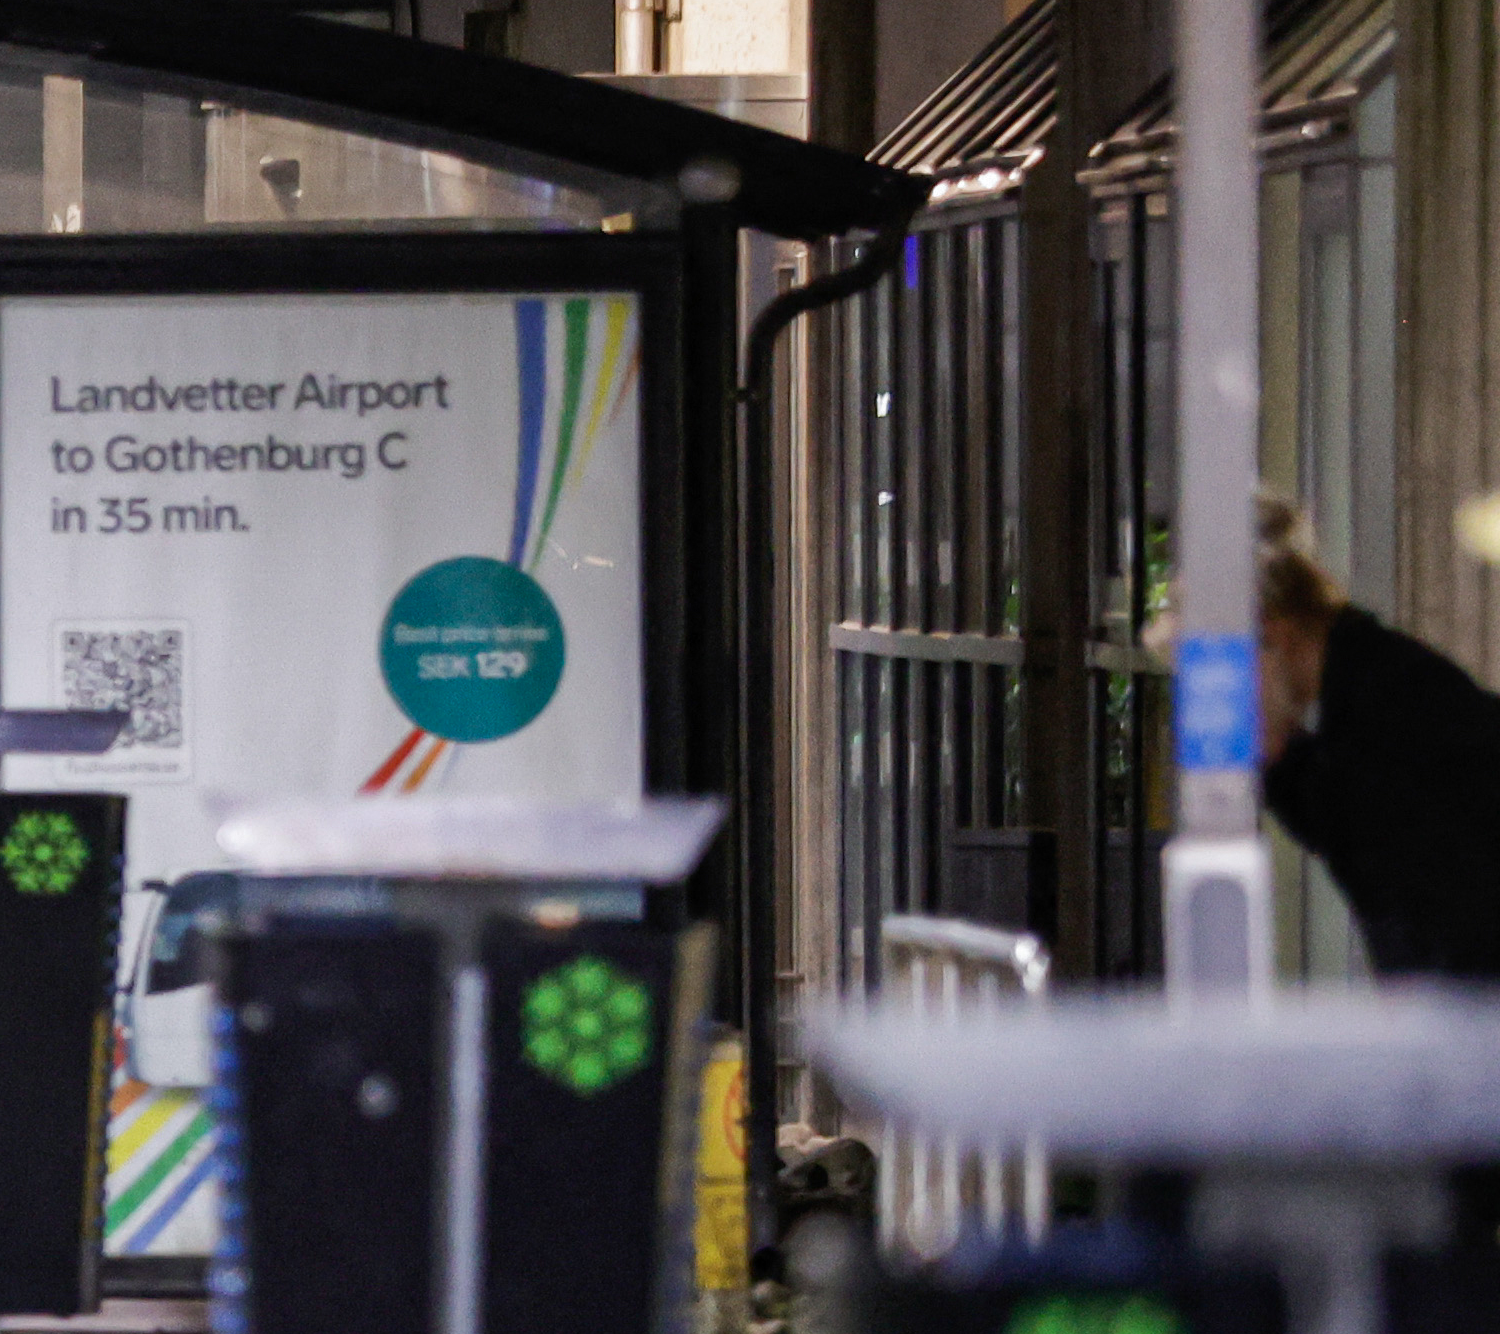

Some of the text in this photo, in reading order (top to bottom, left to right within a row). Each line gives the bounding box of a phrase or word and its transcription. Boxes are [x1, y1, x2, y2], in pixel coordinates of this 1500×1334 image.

[50, 372, 450, 417] Landvetter Airport
[50, 431, 409, 478] to Gothenburg C
[50, 495, 250, 534] in 35 min.
